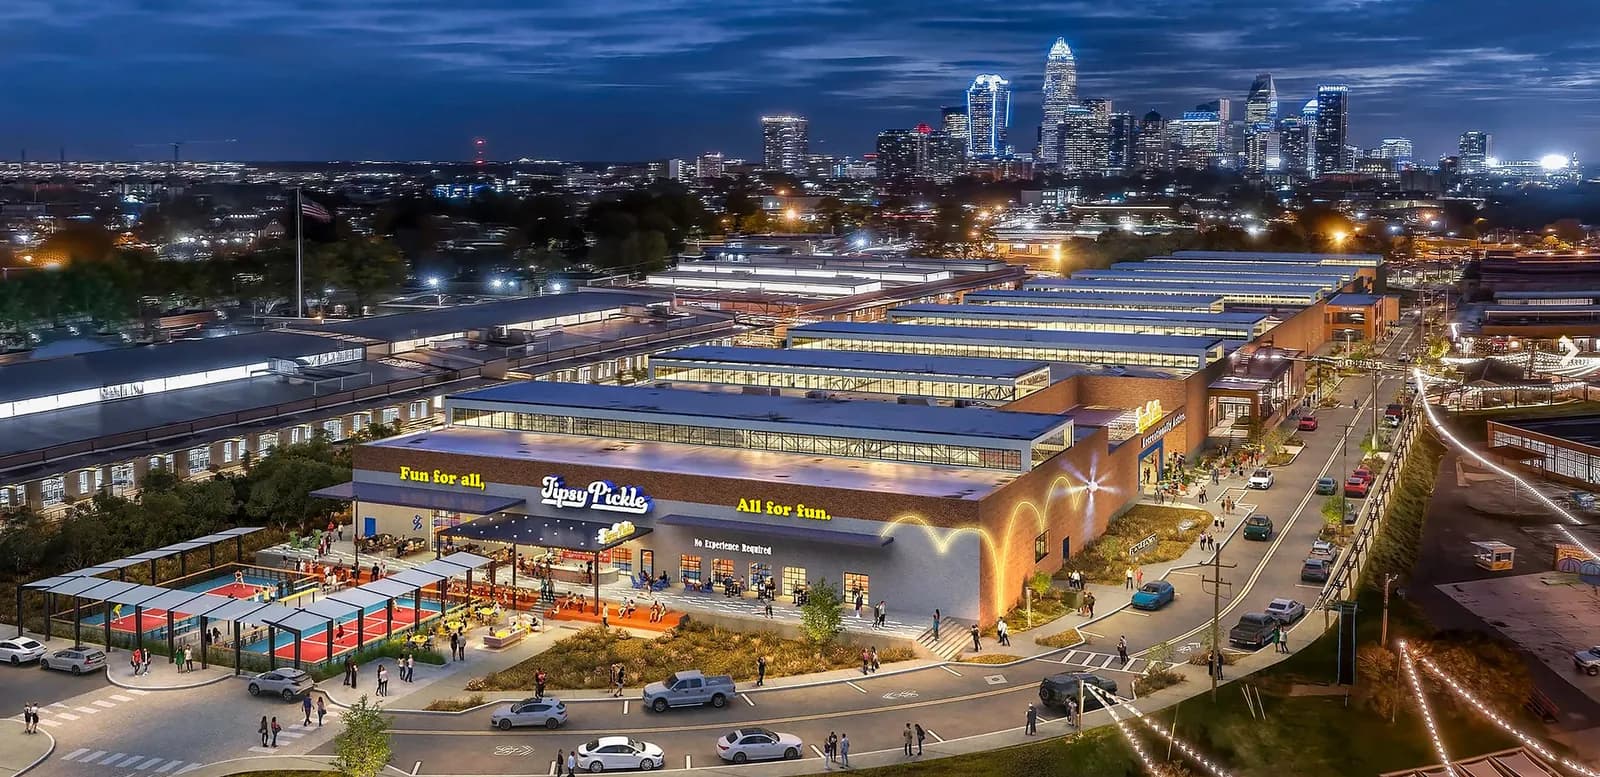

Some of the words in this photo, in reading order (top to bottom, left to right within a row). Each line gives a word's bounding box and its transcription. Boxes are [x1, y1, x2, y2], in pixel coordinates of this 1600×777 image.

[400, 466, 430, 482] Fun
[433, 469, 457, 485] for
[461, 473, 486, 491] all,
[541, 476, 588, 508] Tipsy
[588, 481, 648, 514] Pickle
[736, 498, 761, 513] All
[766, 501, 792, 516] for
[797, 504, 831, 520] fun.
[694, 538, 702, 547] No
[705, 539, 740, 552] Experience
[741, 543, 772, 555] Required
